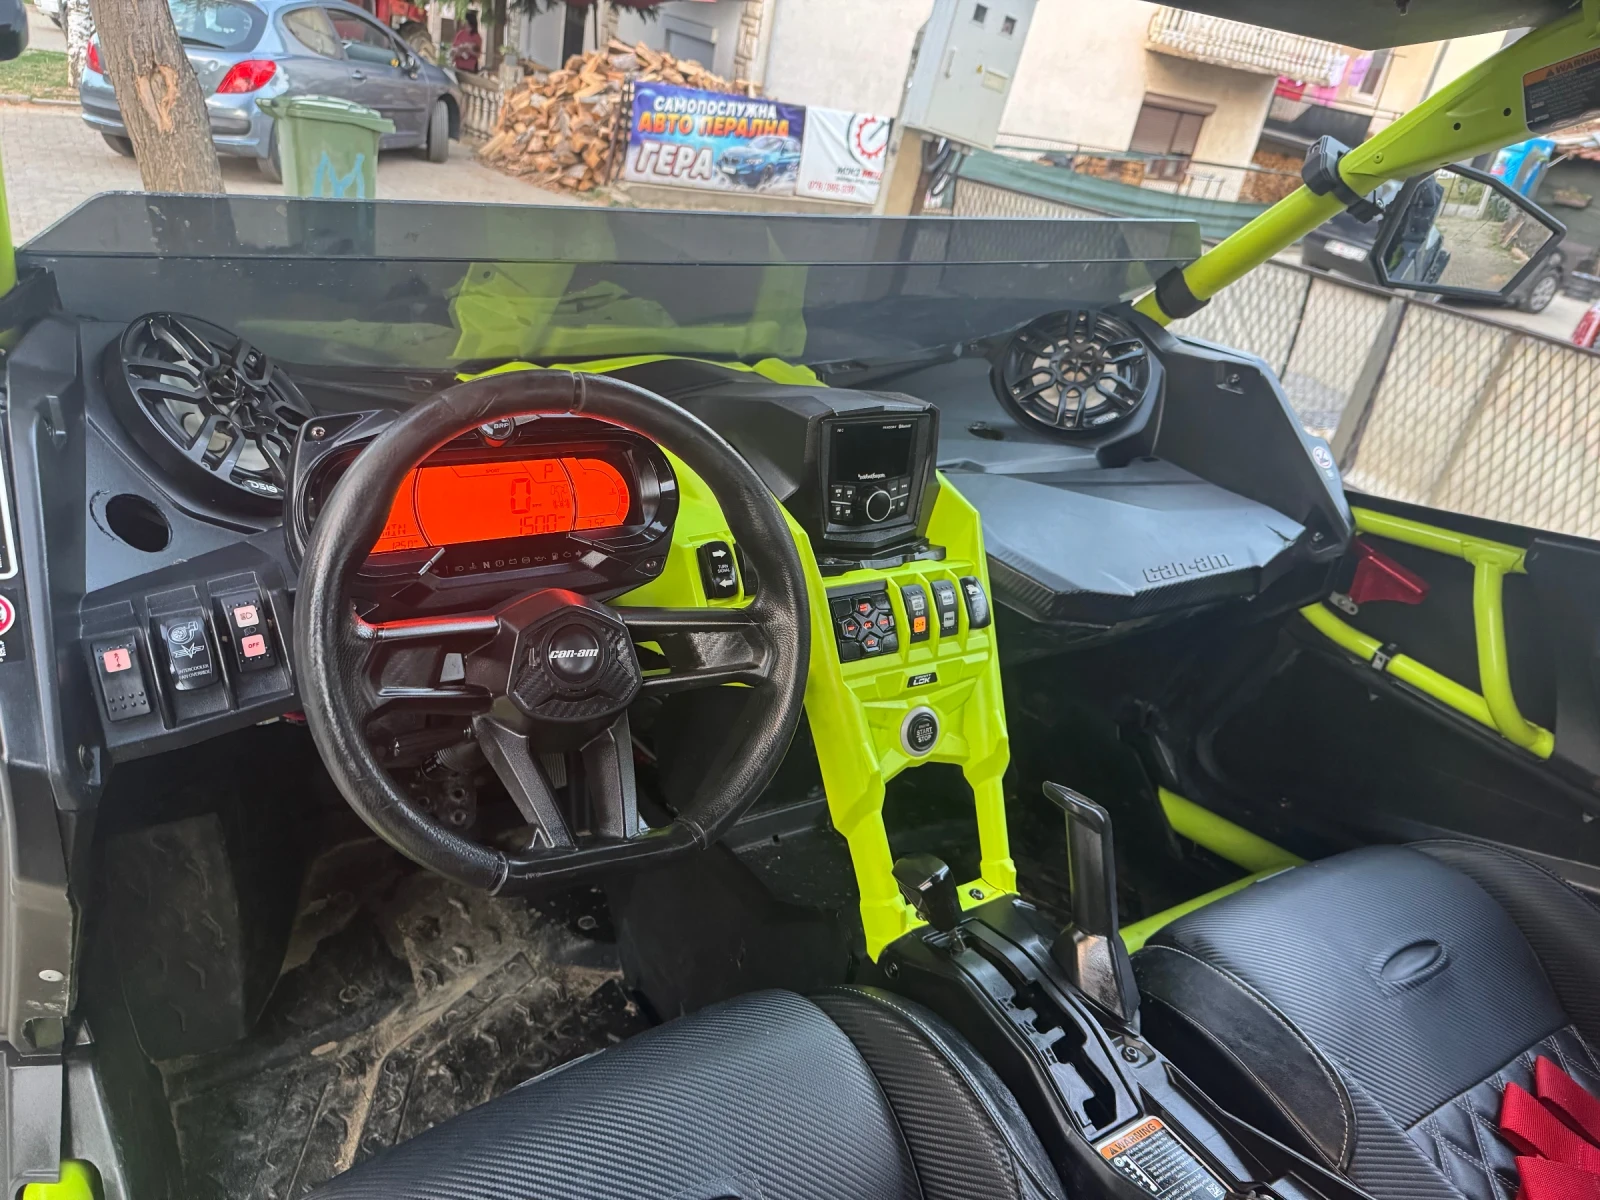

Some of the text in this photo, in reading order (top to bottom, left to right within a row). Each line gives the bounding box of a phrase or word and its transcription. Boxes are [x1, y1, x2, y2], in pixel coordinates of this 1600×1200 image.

[653, 95, 777, 119] САМОПОСЛУЖНА
[638, 111, 790, 138] АВТО ПЕРАЛНА
[634, 140, 714, 180] ГЕРА
[510, 477, 532, 515] 0
[519, 513, 557, 534] 1500
[1142, 554, 1234, 583] can-am
[549, 648, 599, 659] can-am
[916, 727, 933, 736] START
[917, 734, 932, 743] STOP
[1114, 1122, 1157, 1151] WARNING
